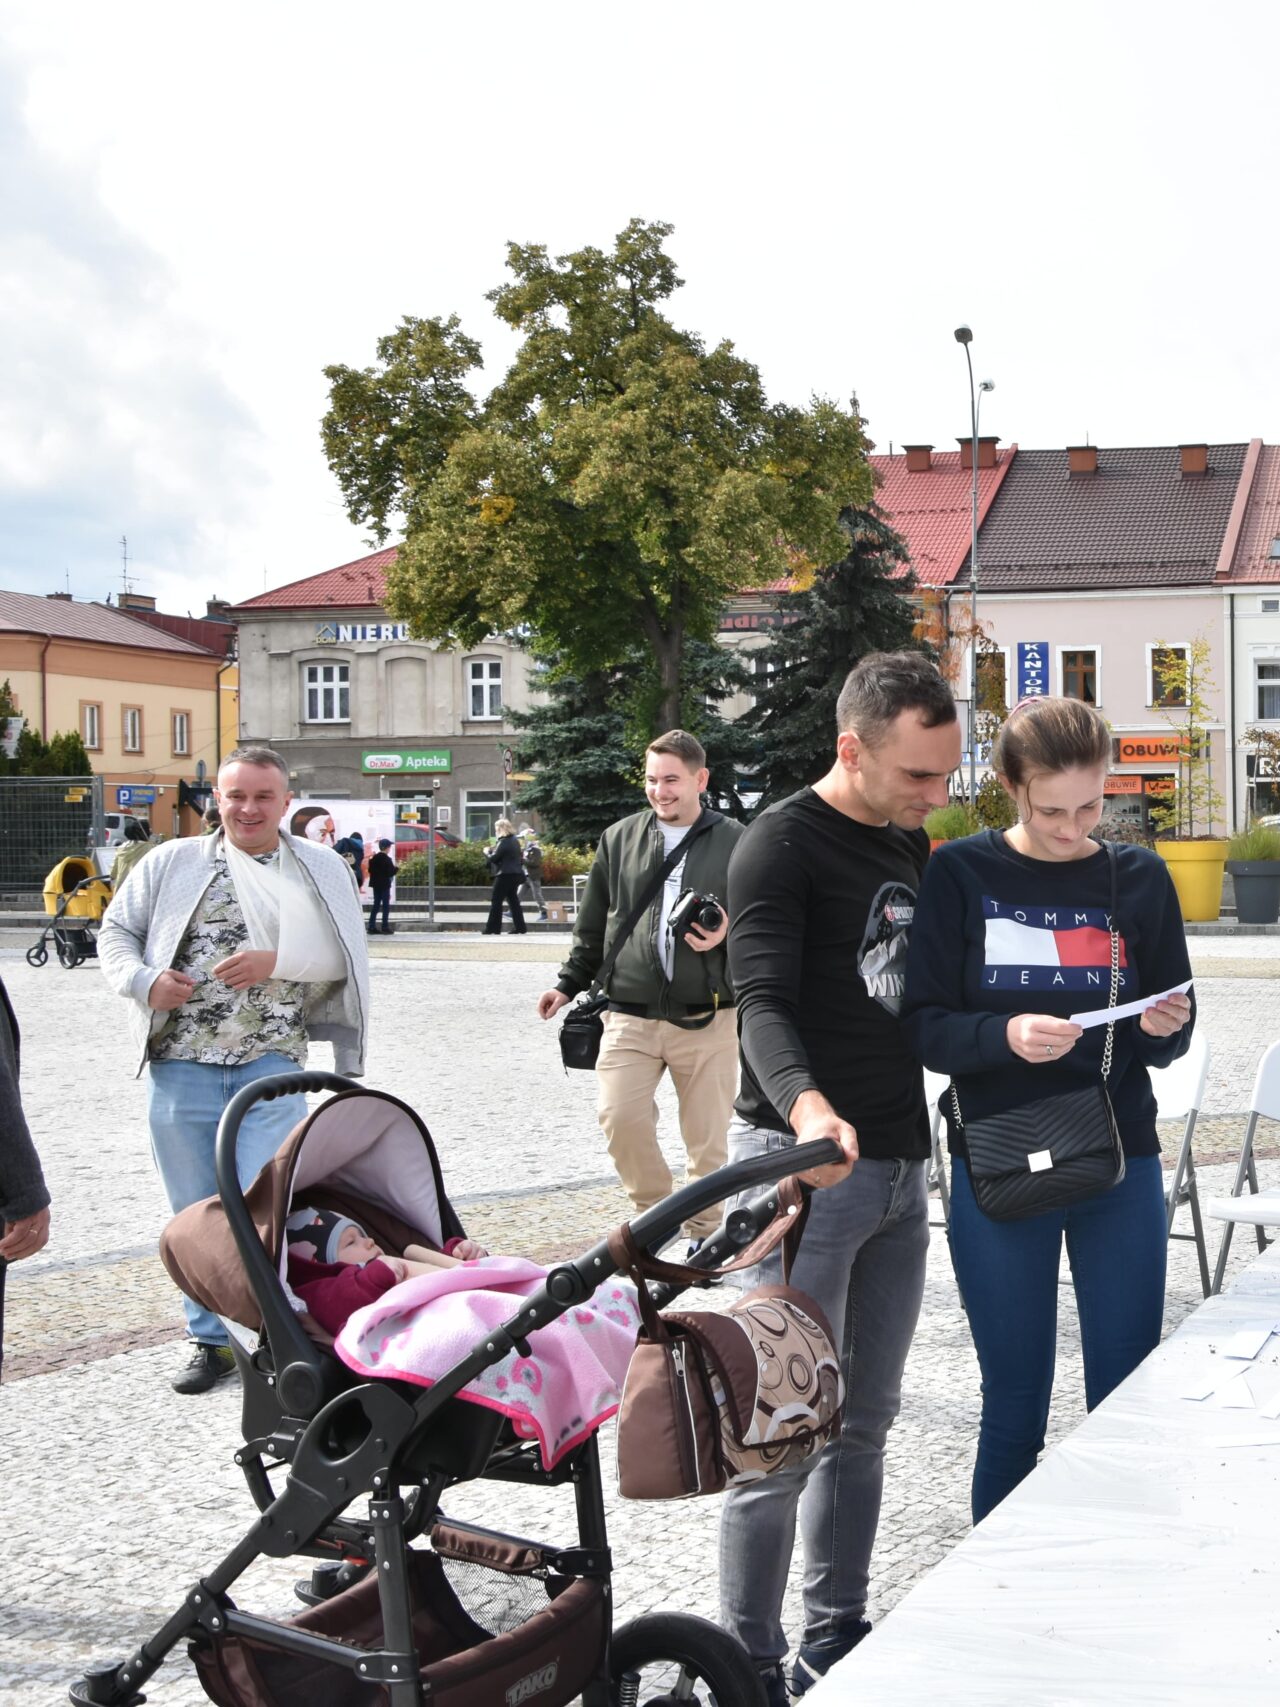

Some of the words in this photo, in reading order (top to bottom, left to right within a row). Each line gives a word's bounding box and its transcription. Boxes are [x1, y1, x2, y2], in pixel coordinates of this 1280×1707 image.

[1023, 643, 1044, 695] KANTOR
[405, 755, 448, 769] Apteka
[119, 789, 130, 804] P
[990, 899, 1113, 926] TOMMY
[988, 970, 1127, 986] JEANS
[506, 1661, 558, 1707] TAKO
